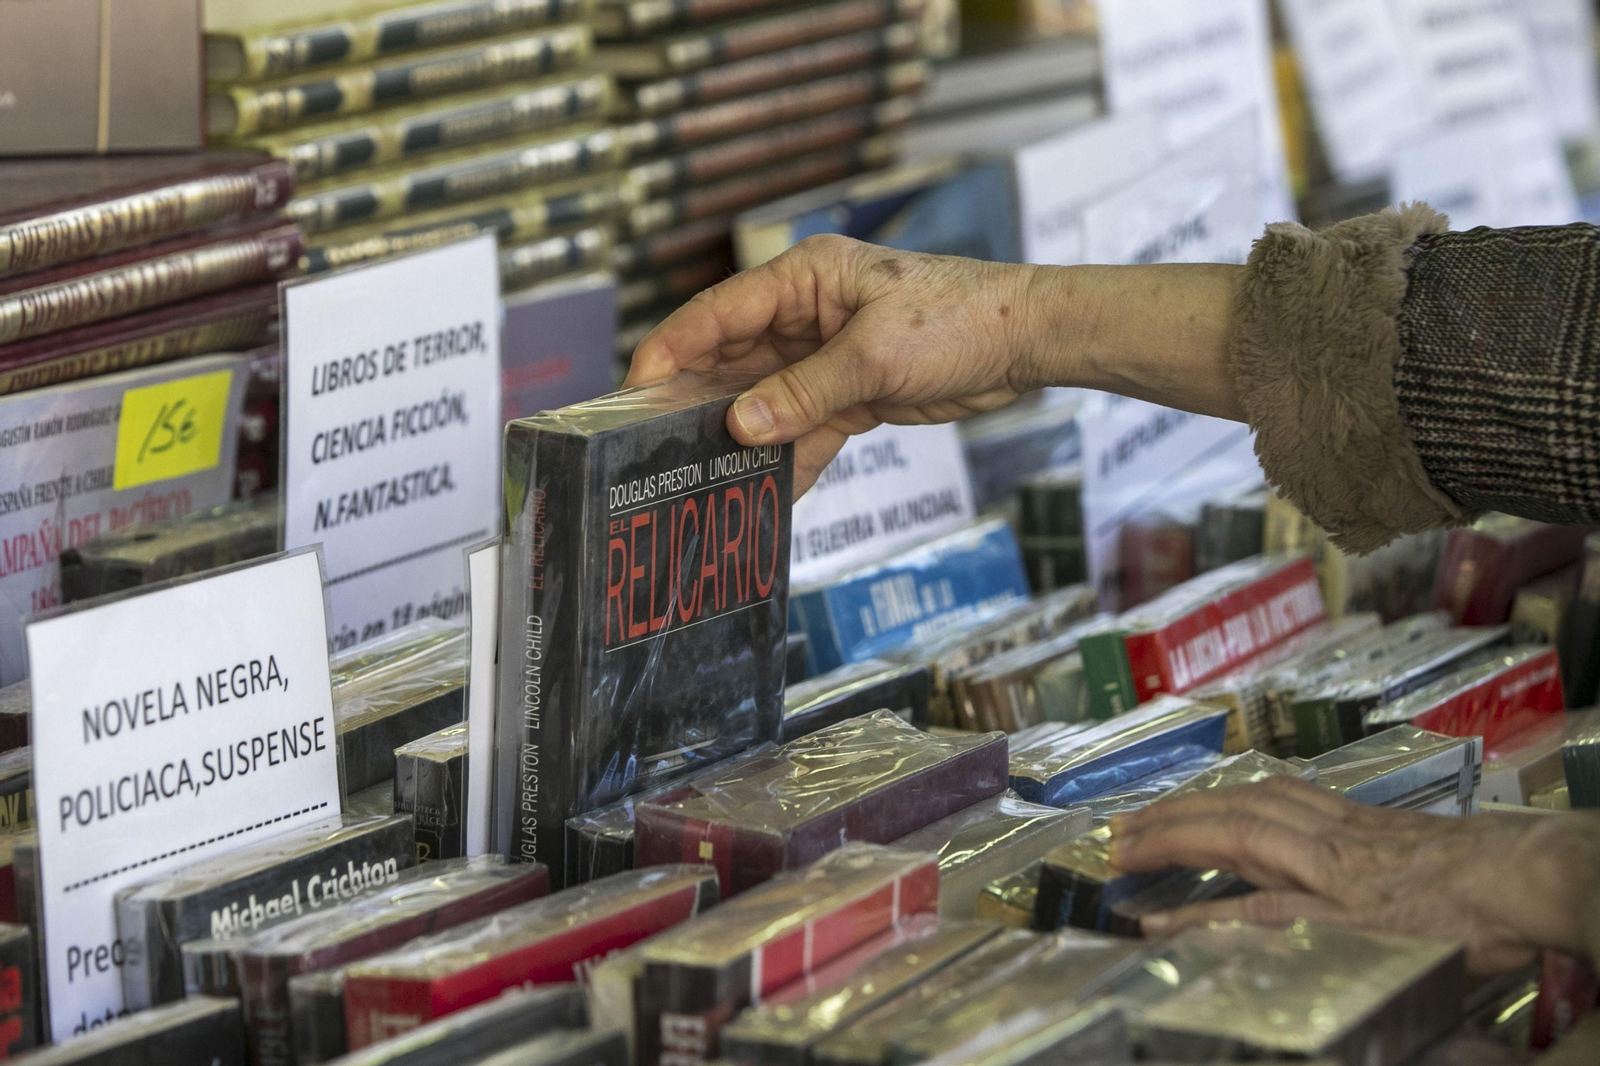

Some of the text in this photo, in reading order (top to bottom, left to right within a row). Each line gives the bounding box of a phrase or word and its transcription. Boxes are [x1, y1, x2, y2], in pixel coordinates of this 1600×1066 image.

[311, 347, 378, 397] LIBROS
[383, 340, 408, 377] DE
[413, 320, 487, 369] TERROR,
[311, 386, 468, 466] CIENCIA FICCIÓN,
[609, 443, 782, 510] DOUGLAS PRESTON LINCOLN CHILD
[529, 487, 548, 591] EL RELICARIO
[605, 474, 780, 647] RELICARIO
[609, 518, 630, 535] EL
[81, 654, 290, 744] NOVELA NEGRA,
[520, 614, 543, 865] UGLAS PRESTON LINCOLN CHILD
[211, 856, 400, 941] Michael Crichton
